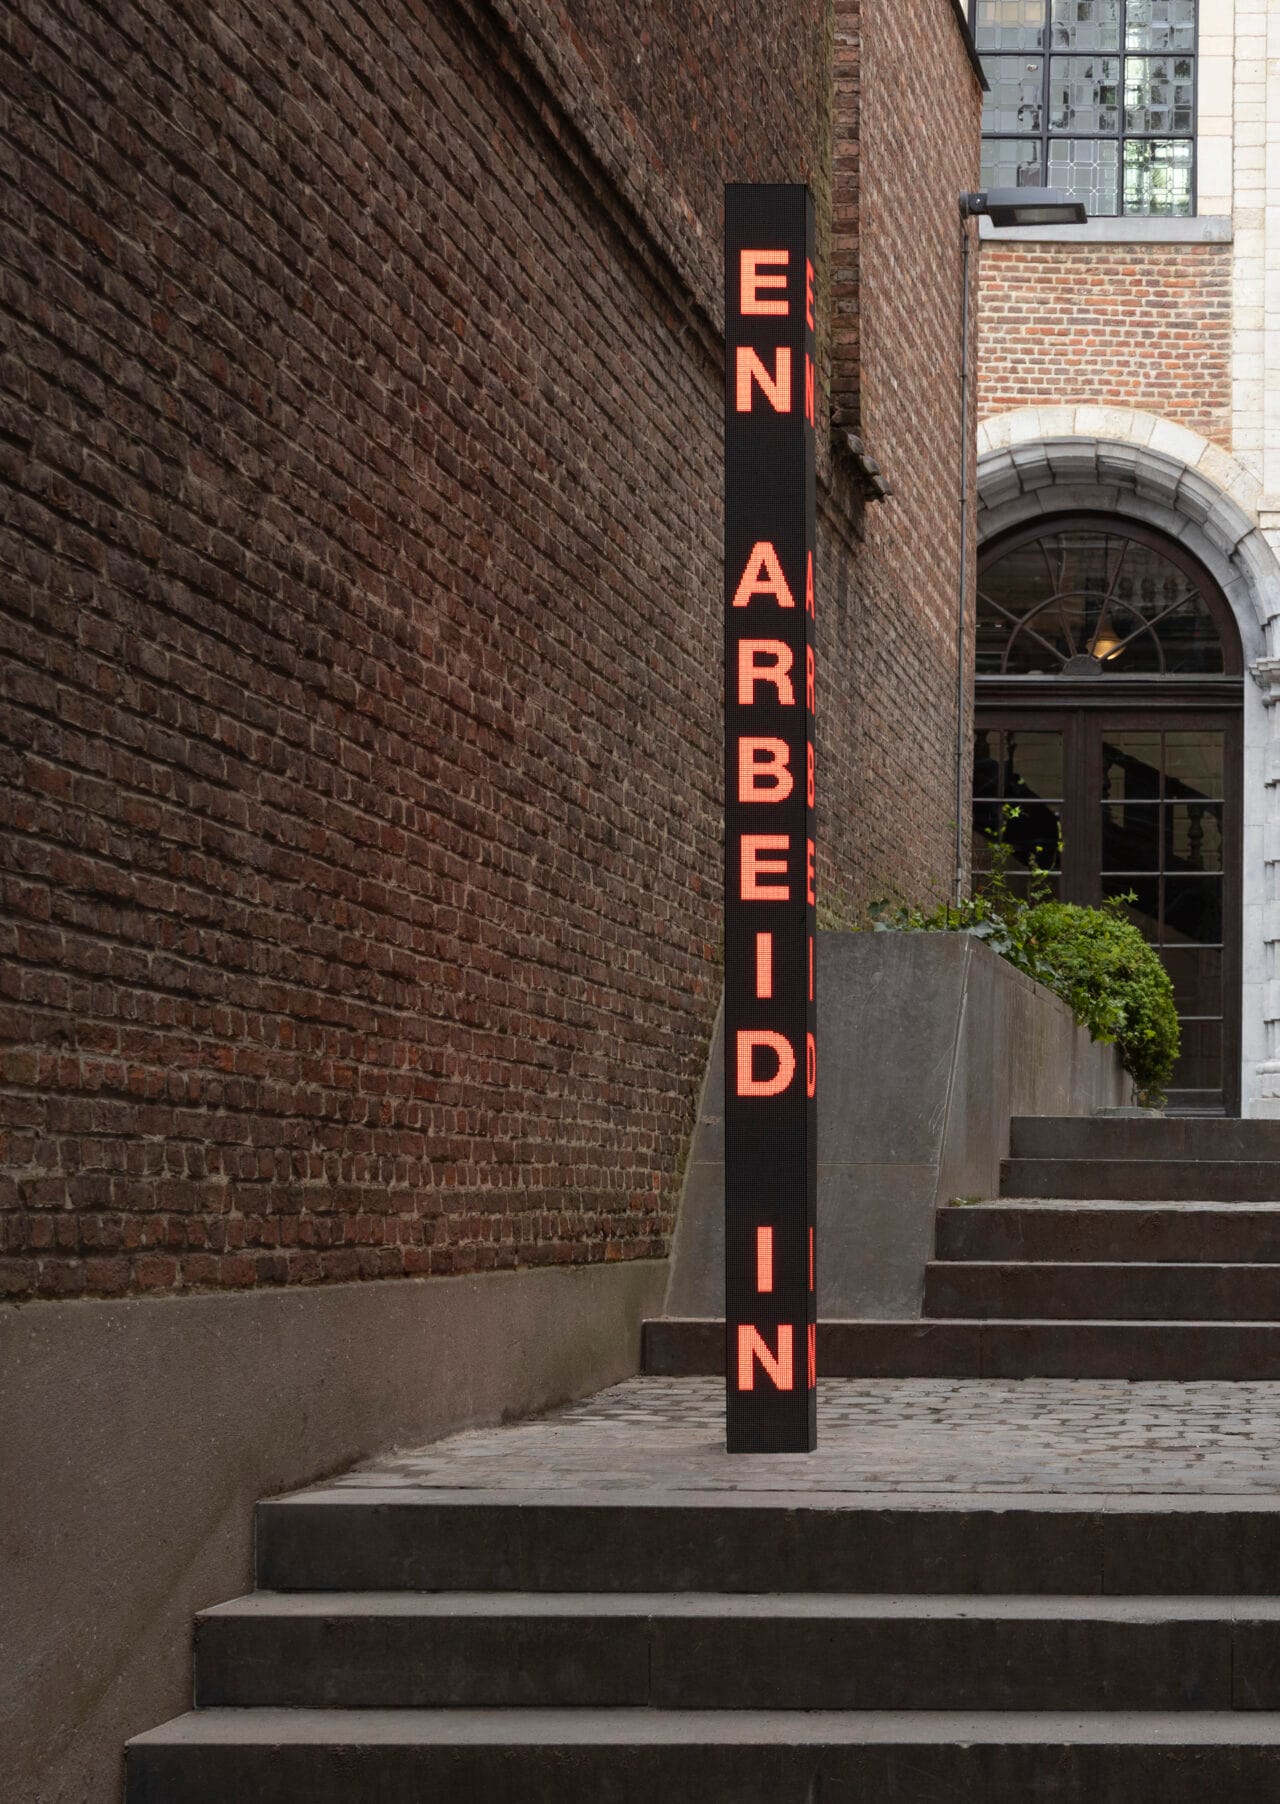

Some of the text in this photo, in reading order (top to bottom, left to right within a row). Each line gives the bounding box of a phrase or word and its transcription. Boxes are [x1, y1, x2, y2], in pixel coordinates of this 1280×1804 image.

[733, 250, 796, 1390] EN ARBEID IN
[805, 257, 817, 1389] EN ARBEID IN
